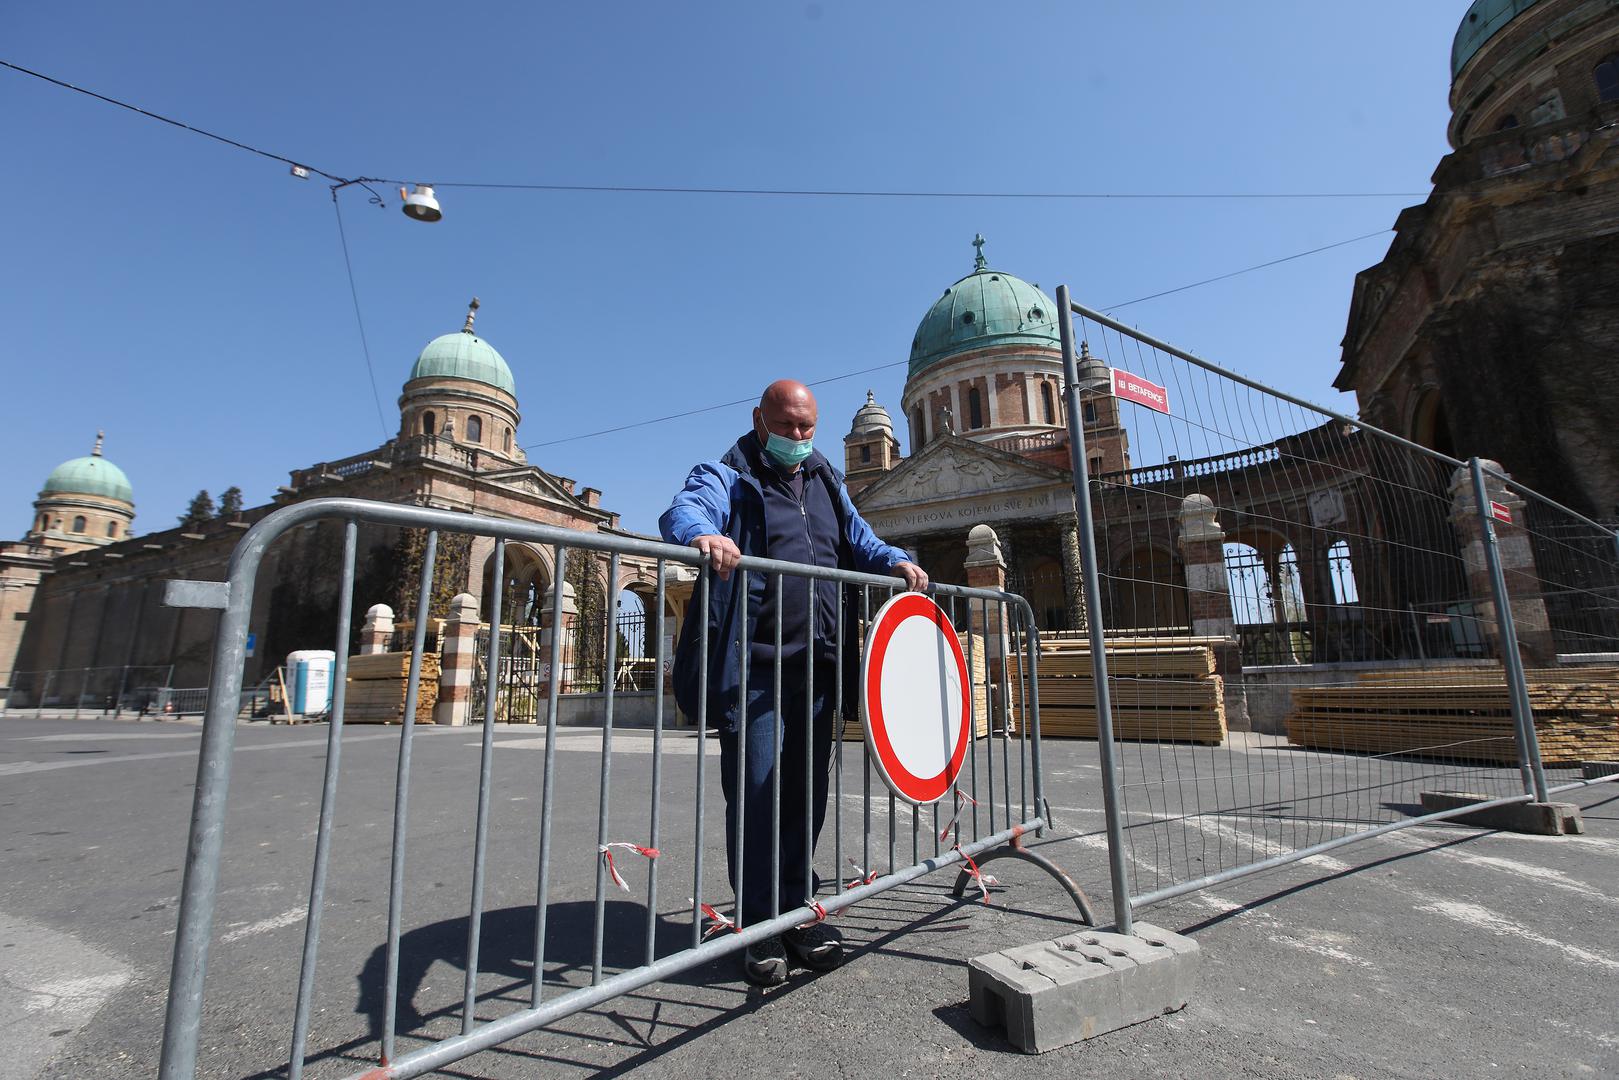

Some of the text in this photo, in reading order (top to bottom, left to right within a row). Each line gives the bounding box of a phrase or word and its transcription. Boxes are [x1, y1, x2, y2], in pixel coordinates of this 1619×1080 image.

[1127, 382, 1164, 404] BETAFENCE
[871, 518, 901, 530] RALJU
[905, 511, 953, 525] VJEKOVA
[958, 504, 1000, 518] KOJEMU
[1003, 499, 1024, 512] SVE
